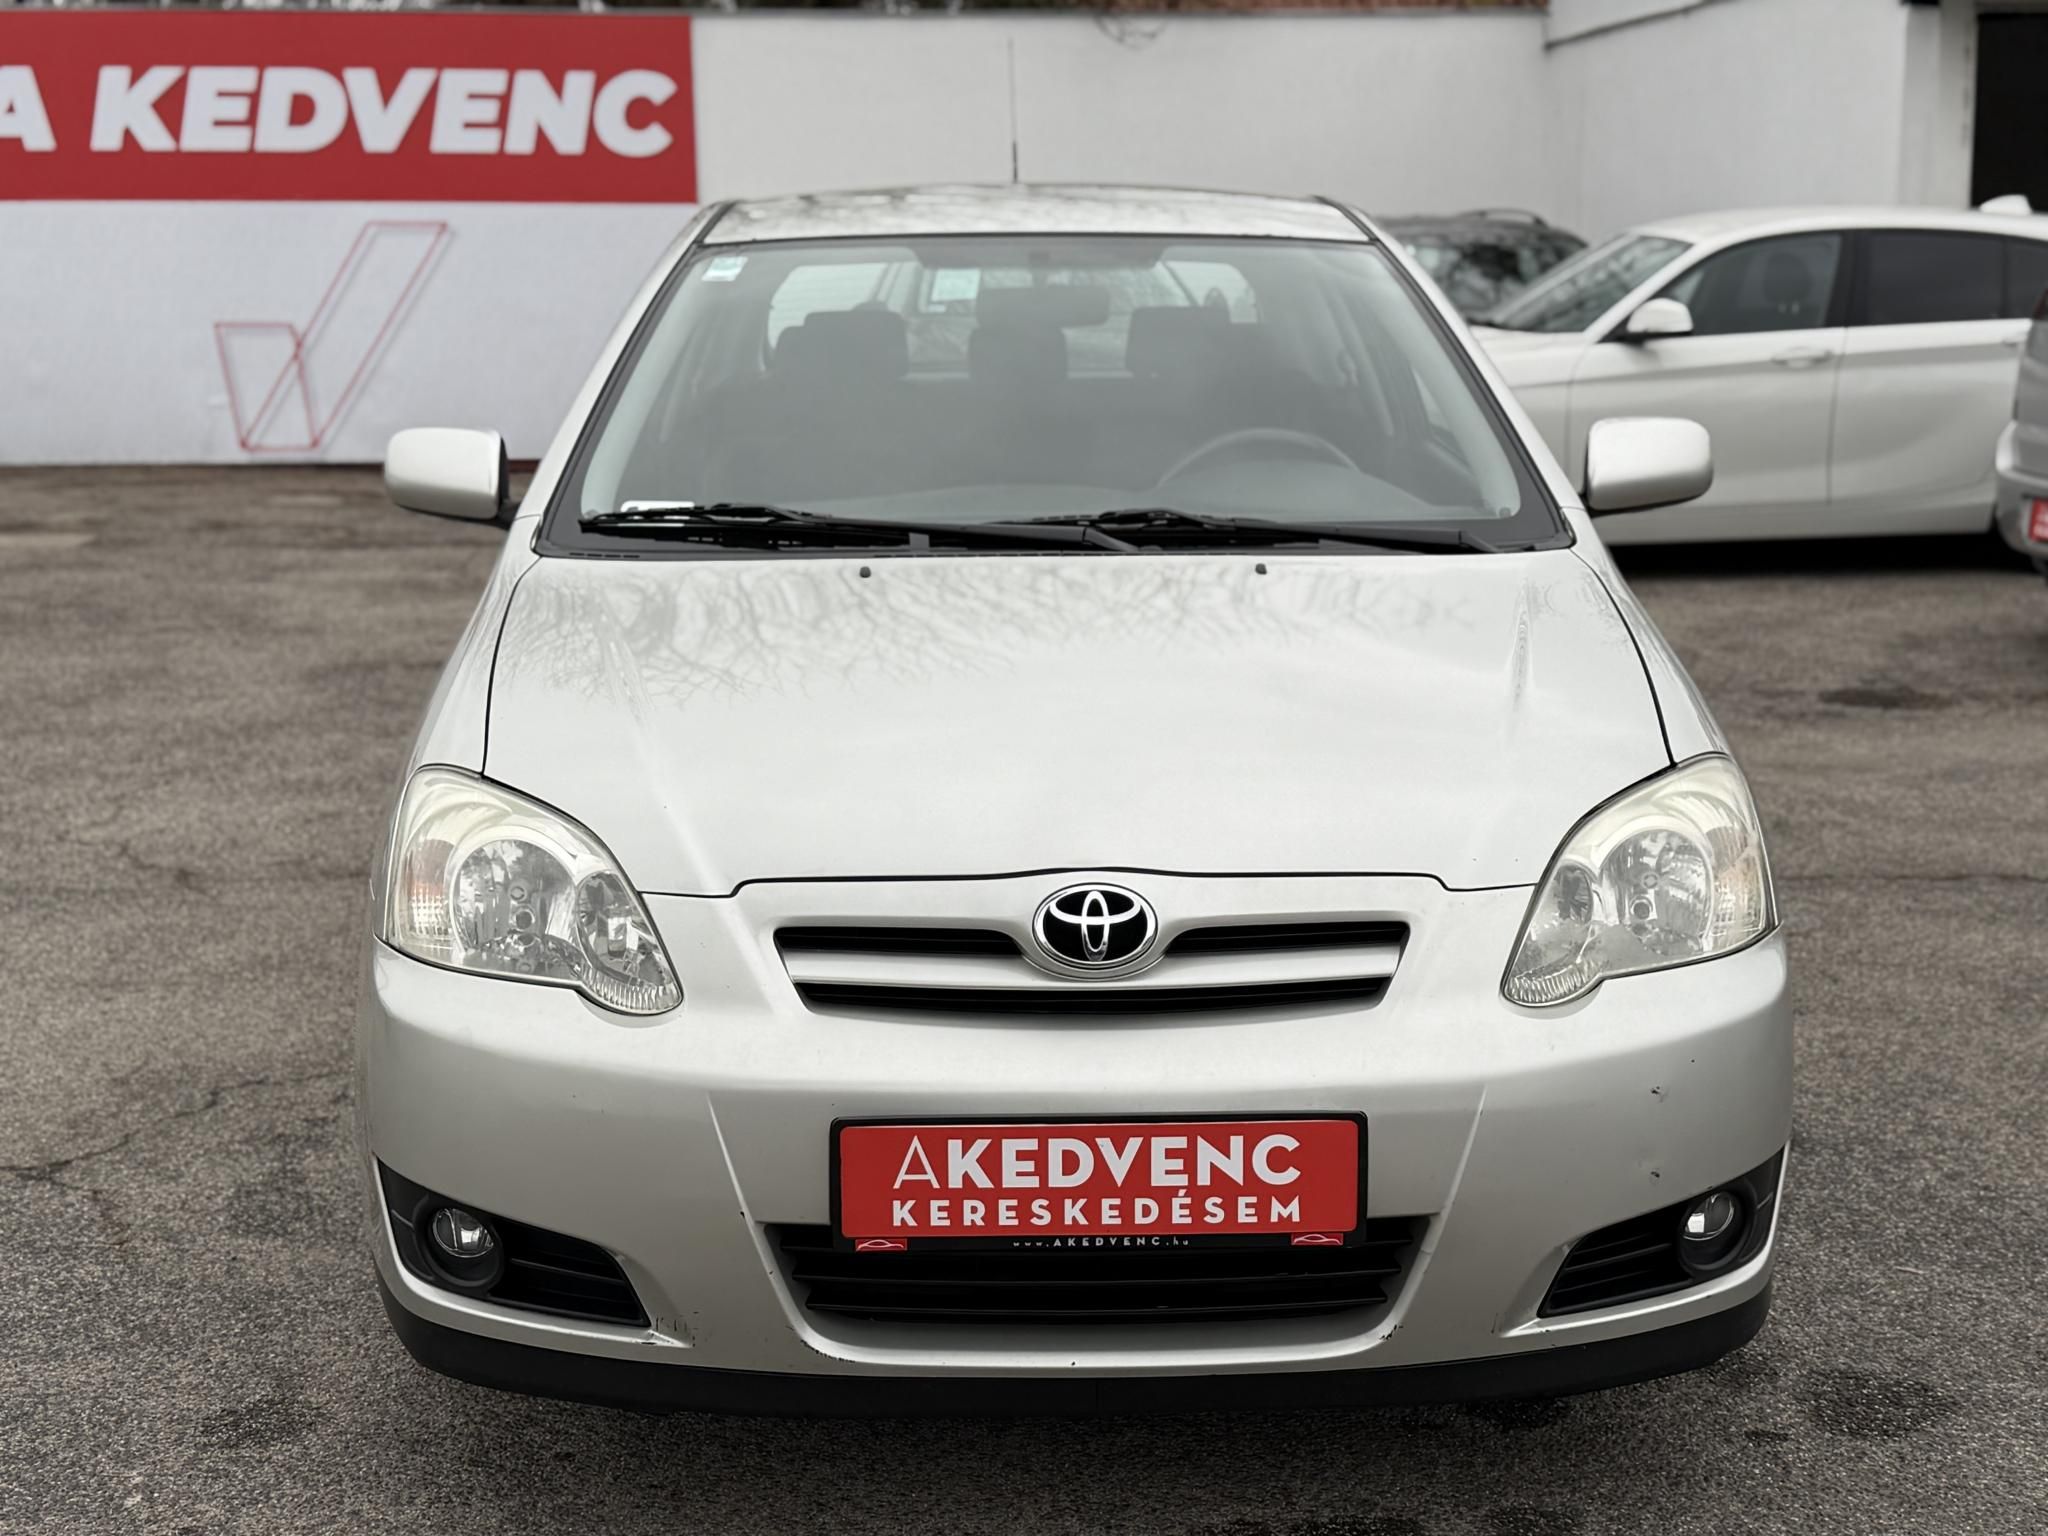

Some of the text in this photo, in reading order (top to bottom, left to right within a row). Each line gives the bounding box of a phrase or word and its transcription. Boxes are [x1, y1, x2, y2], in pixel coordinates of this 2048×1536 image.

[90, 65, 677, 158] KEDVENC
[892, 1190, 1301, 1227] KERESKEDÉSEM
[1013, 1236, 1189, 1247] www.AKEDVENC.hu
